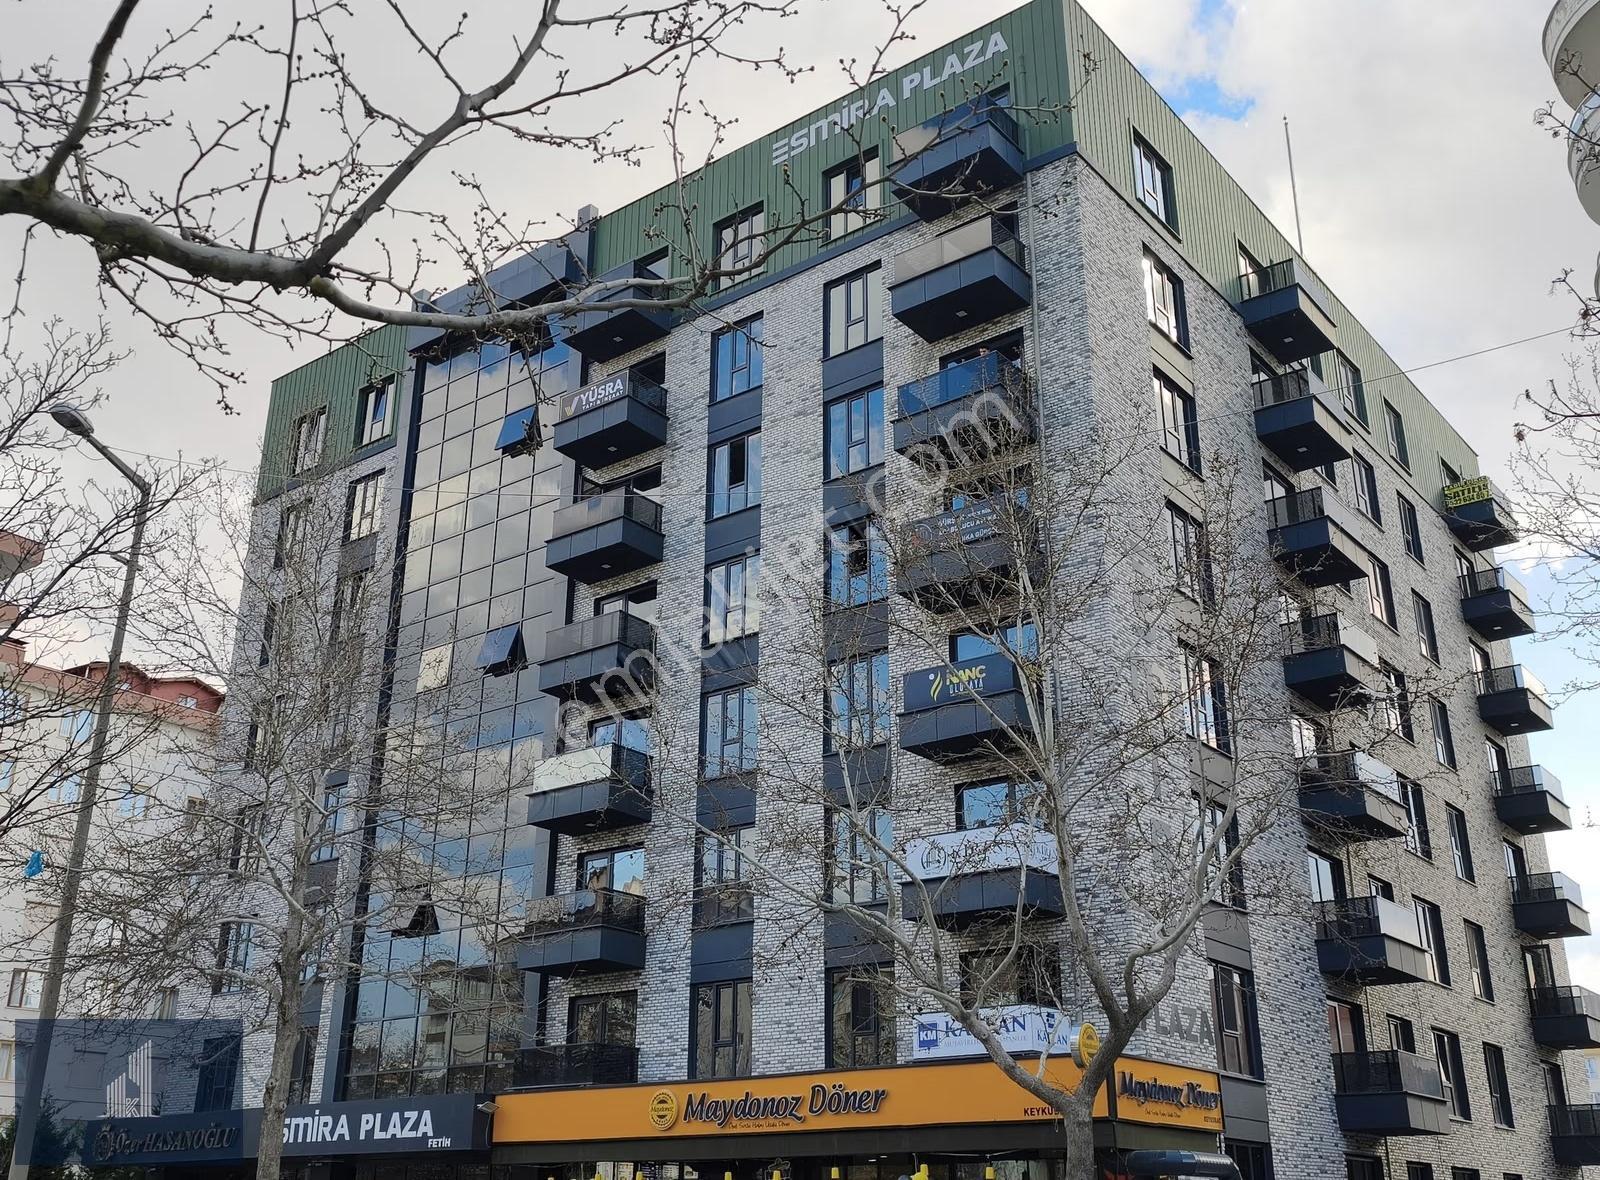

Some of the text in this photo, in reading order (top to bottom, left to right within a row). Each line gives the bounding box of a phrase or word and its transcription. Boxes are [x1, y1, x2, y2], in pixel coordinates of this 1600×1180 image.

[902, 31, 1008, 99] PLAZA
[580, 379, 624, 405] YÜSRA
[949, 678, 984, 694] ULUAYA
[919, 1030, 936, 1042] KM
[944, 1013, 1027, 1039] KAAN
[1037, 1030, 1068, 1046] KAAN
[683, 1082, 888, 1128] Maydonoz Döner
[143, 1122, 236, 1151] HASANOĞLU
[283, 1109, 434, 1144] SMİRA PLAZA
[428, 1136, 451, 1148] FETİH
